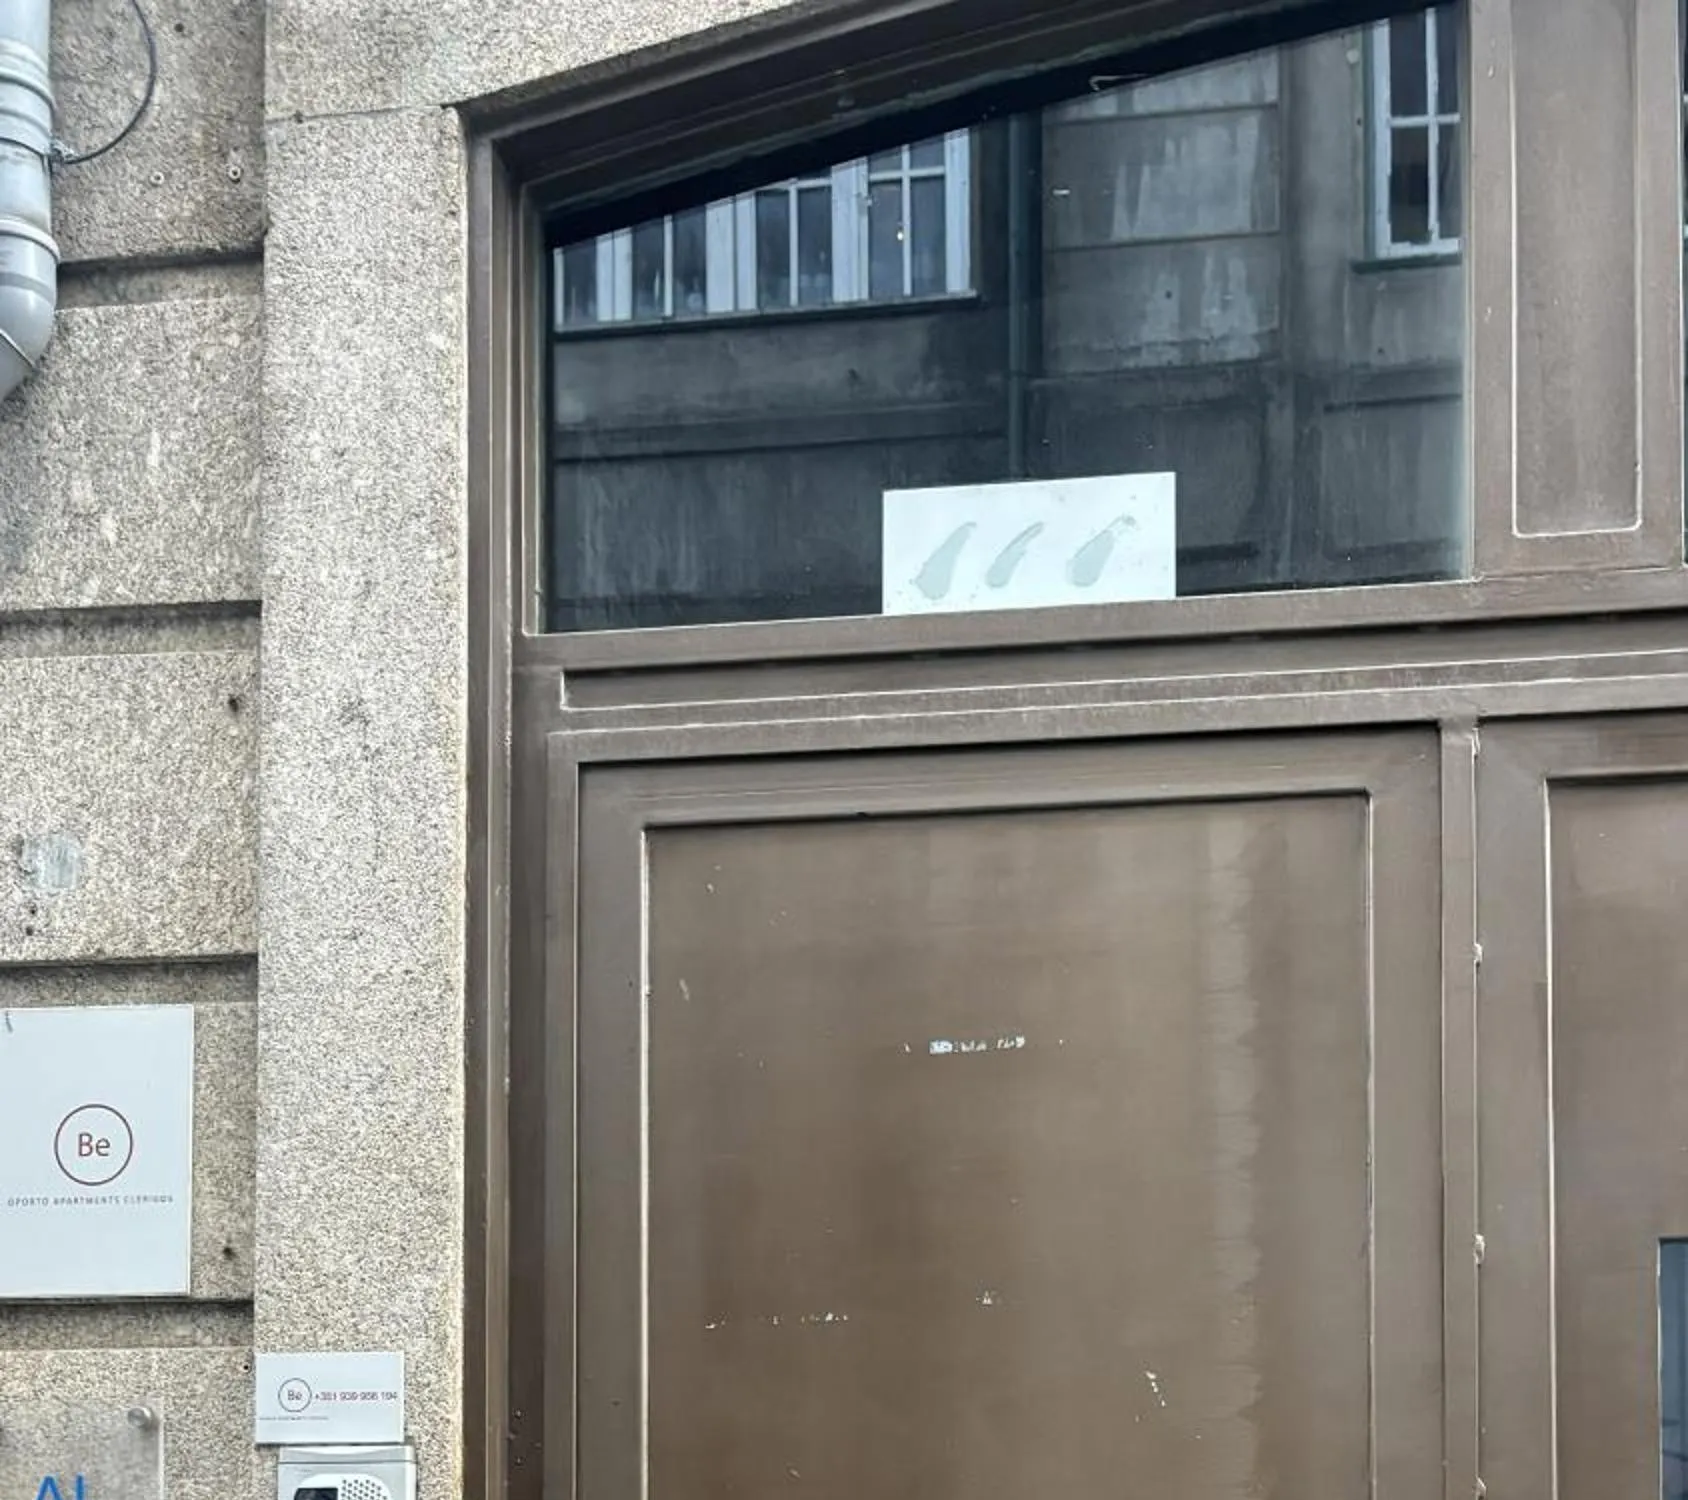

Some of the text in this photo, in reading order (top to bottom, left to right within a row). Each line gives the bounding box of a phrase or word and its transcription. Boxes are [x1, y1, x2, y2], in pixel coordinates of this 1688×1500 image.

[77, 1132, 111, 1157] Be
[7, 1197, 49, 1207] OPORTO
[287, 1389, 302, 1401] Be
